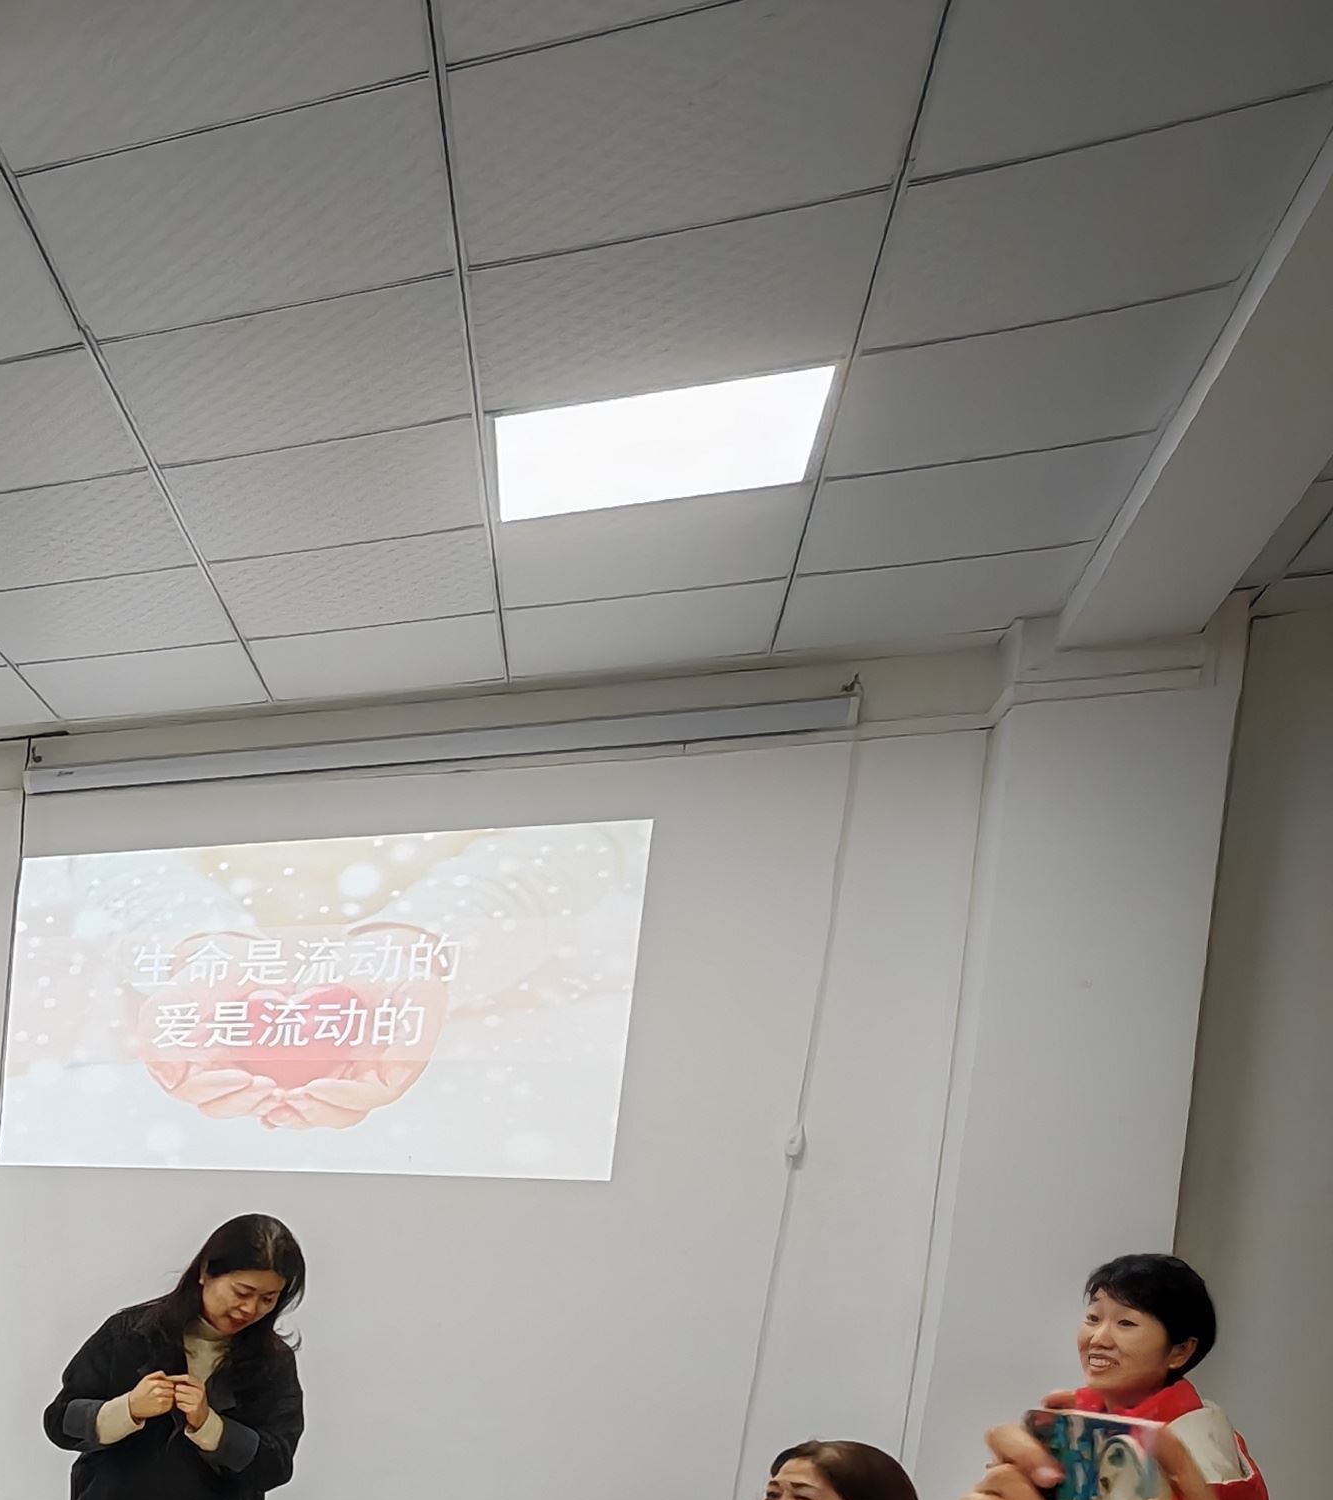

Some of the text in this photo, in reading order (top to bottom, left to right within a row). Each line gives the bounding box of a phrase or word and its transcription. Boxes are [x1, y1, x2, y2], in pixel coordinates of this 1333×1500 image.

[132, 933, 462, 989] 生命是流动的
[151, 998, 425, 1050] 爱是流动的
